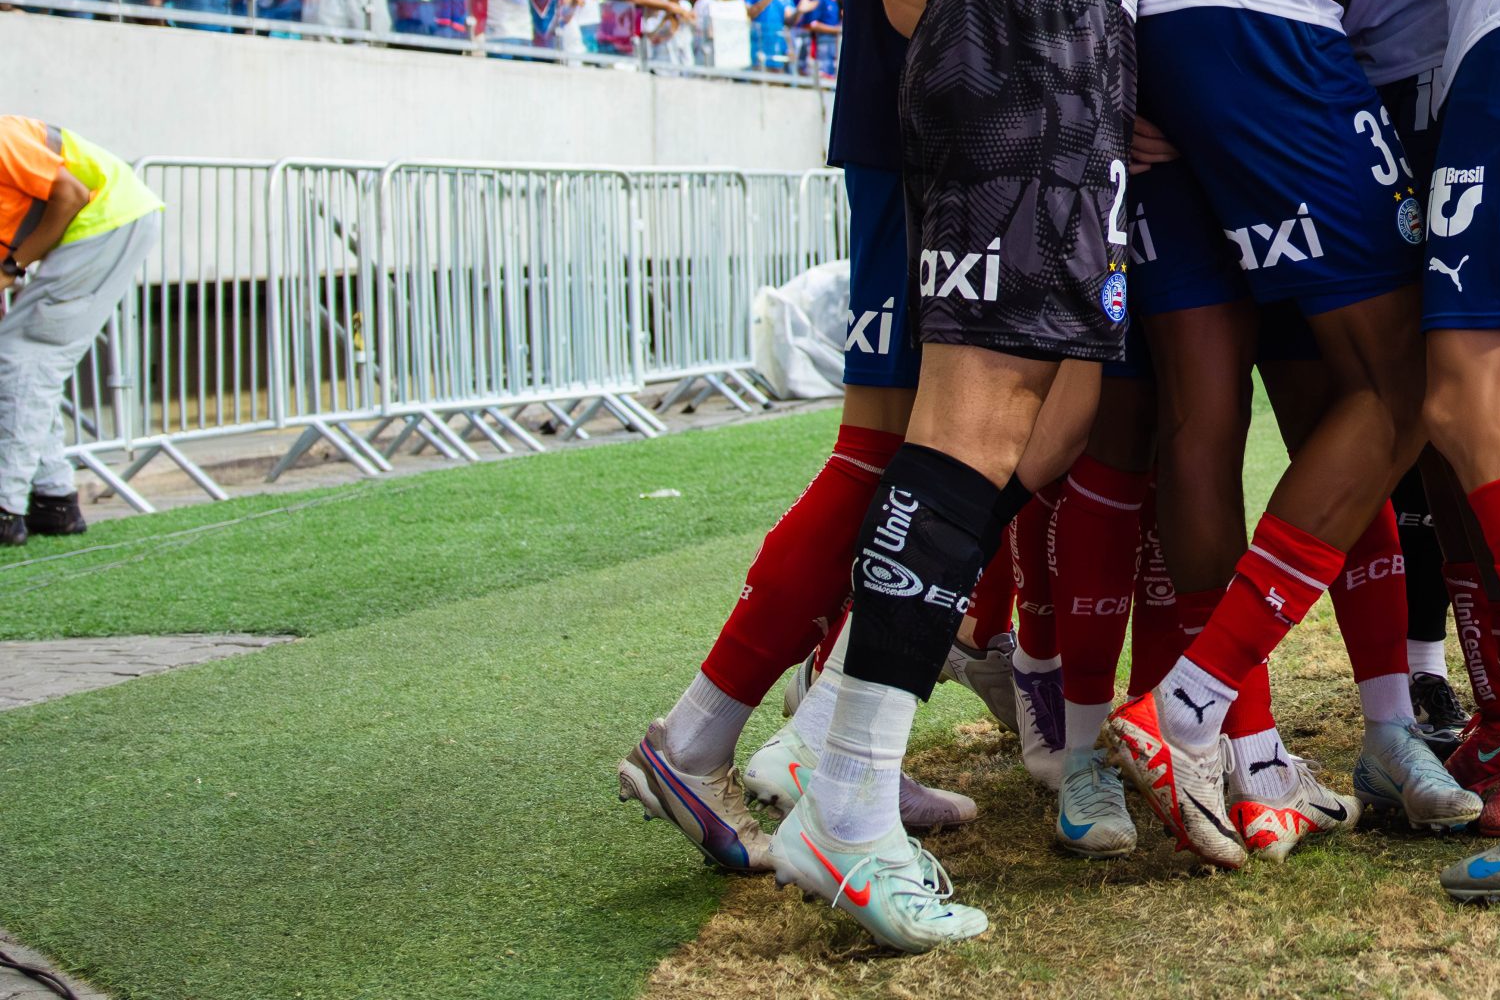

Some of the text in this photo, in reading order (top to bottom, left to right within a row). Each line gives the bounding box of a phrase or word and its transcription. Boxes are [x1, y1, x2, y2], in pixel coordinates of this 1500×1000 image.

[1445, 165, 1485, 184] Brasil
[1346, 555, 1406, 591] ECB
[1453, 593, 1498, 701] UniCesumar
